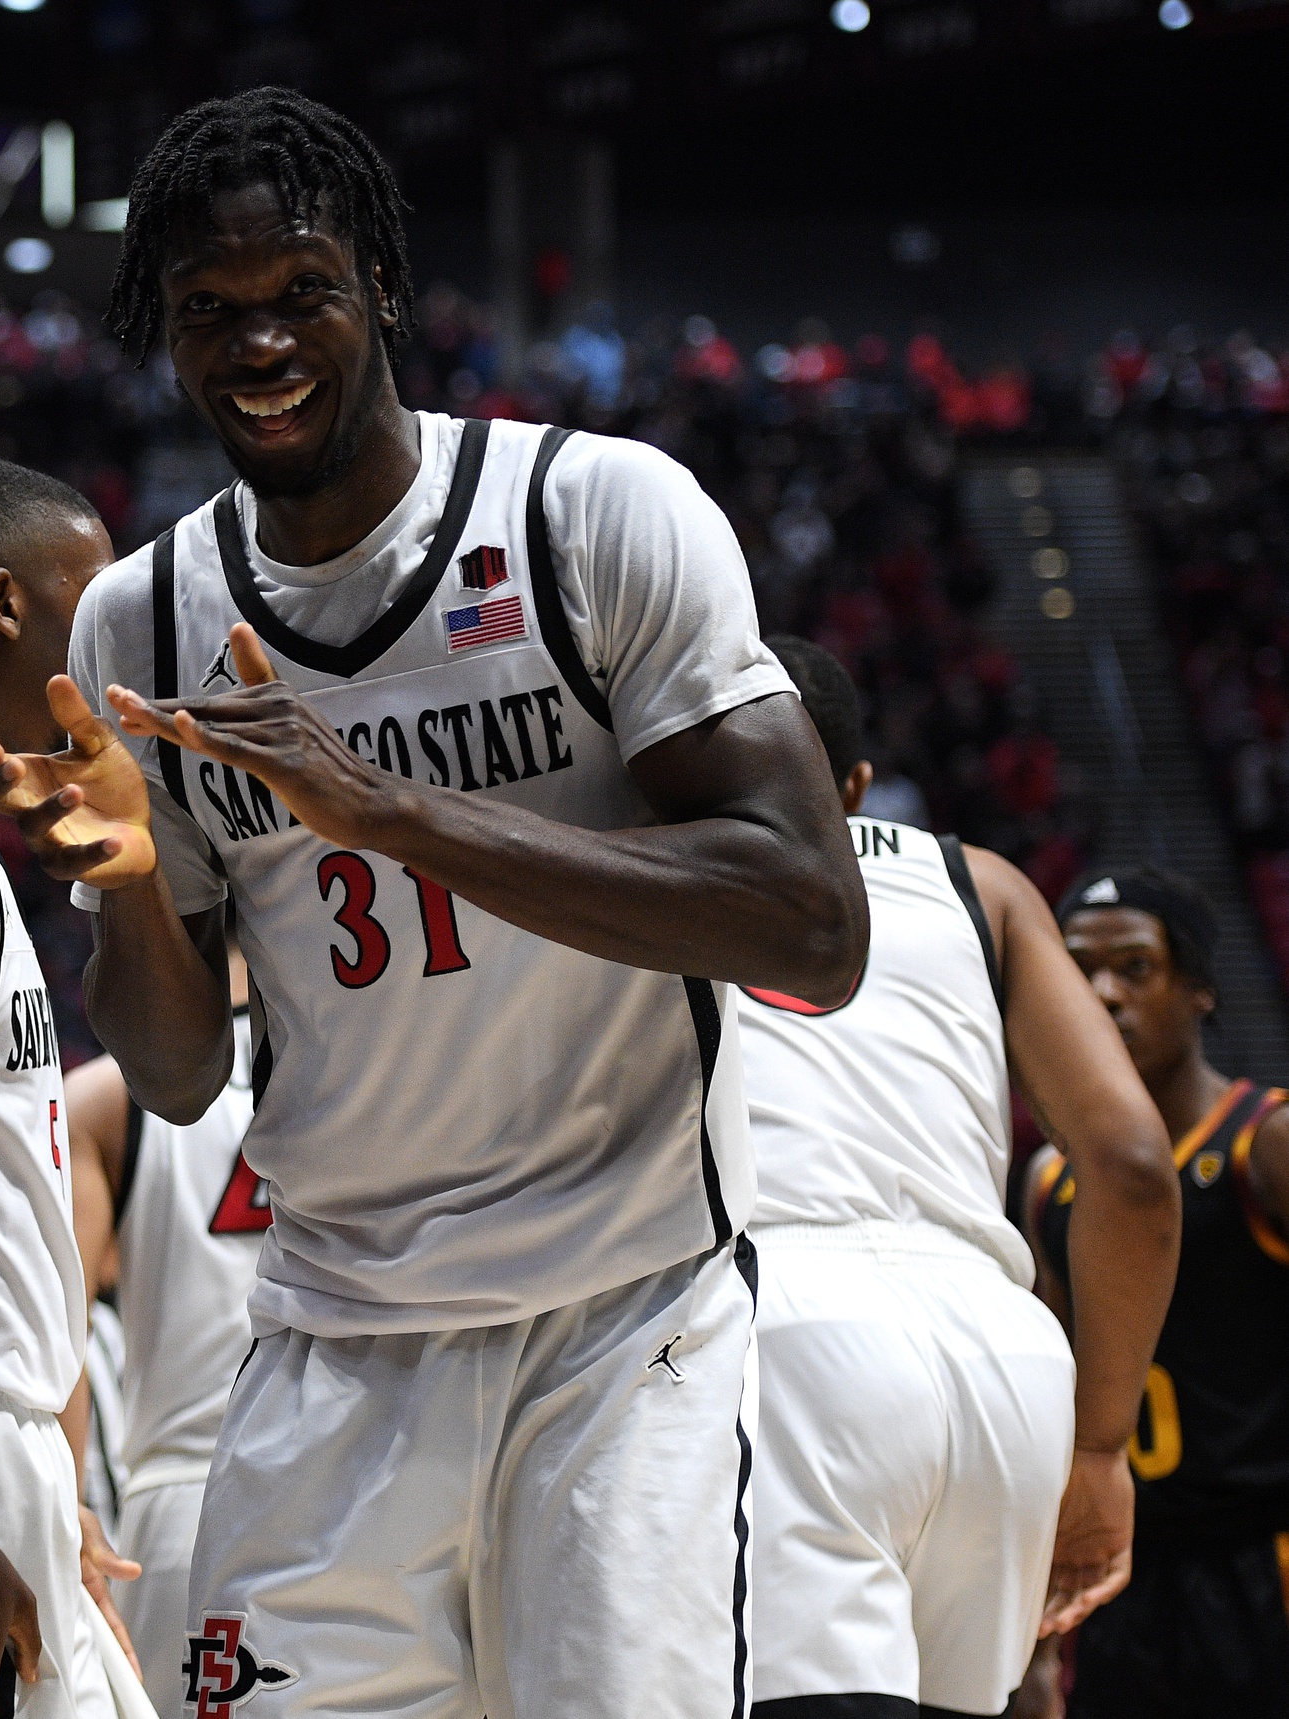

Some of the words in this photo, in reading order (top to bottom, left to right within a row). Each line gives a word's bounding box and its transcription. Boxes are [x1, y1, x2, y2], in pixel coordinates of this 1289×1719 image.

[199, 761, 279, 842] SAN
[418, 685, 574, 792] STATE
[317, 850, 471, 989] 31
